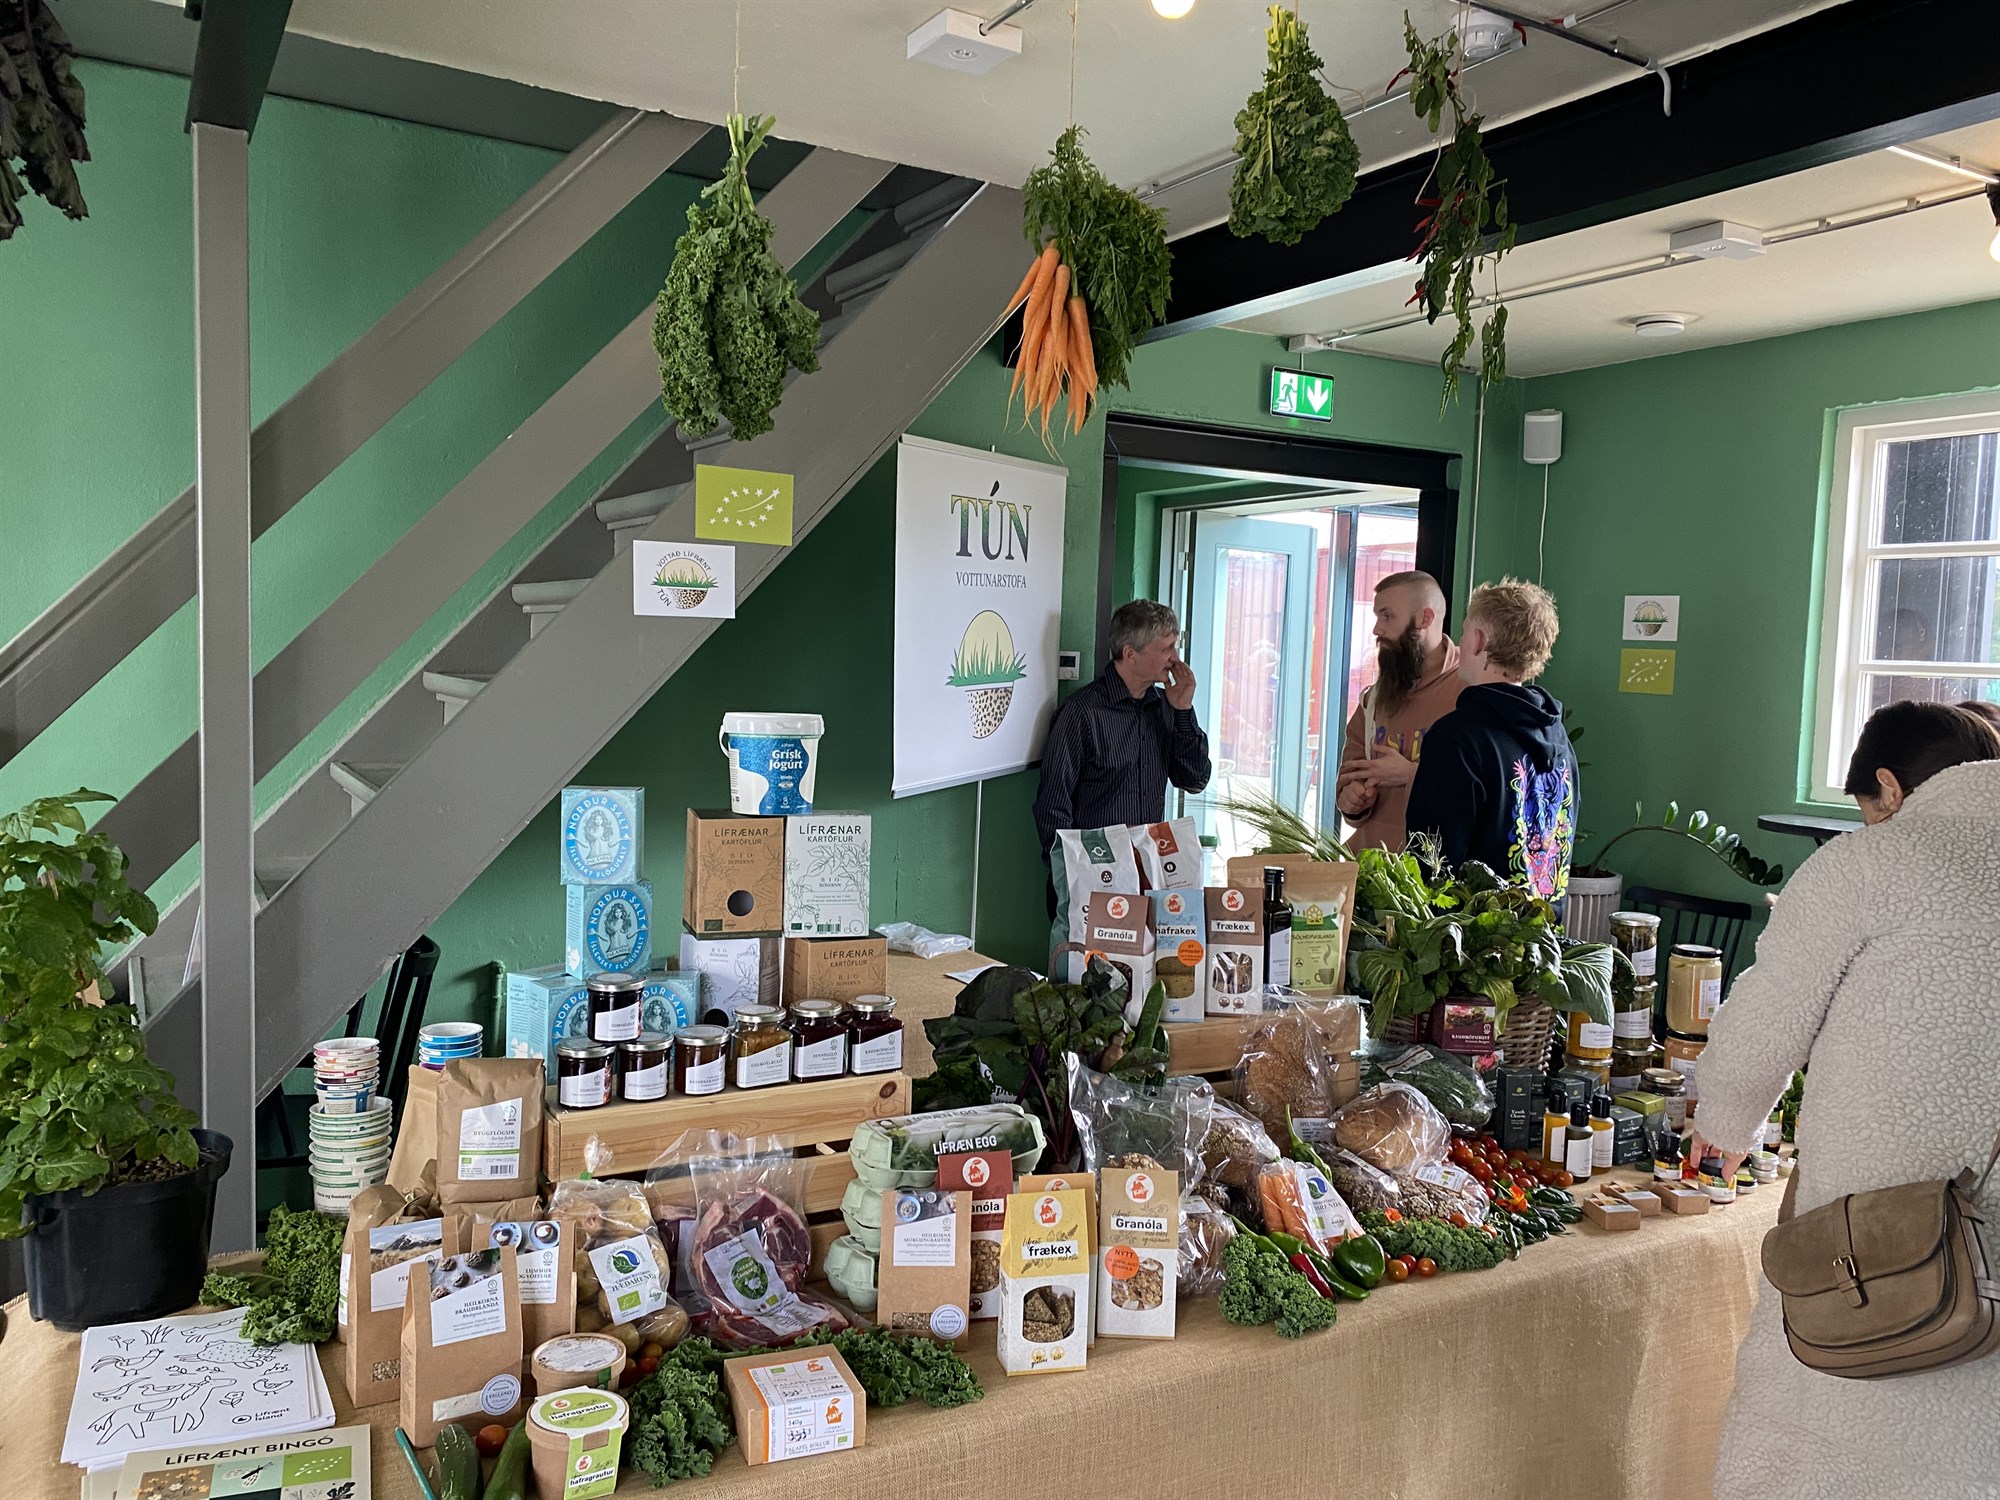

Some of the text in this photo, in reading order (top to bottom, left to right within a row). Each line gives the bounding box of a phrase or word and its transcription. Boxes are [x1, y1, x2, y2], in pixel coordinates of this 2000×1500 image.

[951, 480, 1032, 563] TÚN
[656, 549, 711, 571] VOTTAÐ LÍFRÆNT
[956, 572, 1027, 588] VOTTUNARSTOFA
[657, 588, 672, 607] TÚN
[772, 749, 801, 759] Grísk
[769, 759, 803, 772] jógúrt
[568, 797, 629, 831] NORÐUR SALT
[714, 827, 769, 837] LÍFRÆNAR
[799, 823, 862, 835] LÍFRÆNAR
[807, 835, 854, 843] KARTÖFLUR
[590, 890, 645, 924] NORÐUR SALT
[1216, 922, 1250, 930] frækex
[1097, 929, 1133, 940] Granóla
[823, 948, 874, 960] LÍFRÆNAR
[829, 959, 868, 968] KARTÖFLUR
[668, 994, 687, 1020] SALT
[933, 1135, 997, 1155] LÍFRÆN EGG
[971, 1201, 1000, 1213] anóla
[1116, 1218, 1163, 1230] Granóla
[1029, 1245, 1072, 1257] frækex
[1114, 1249, 1134, 1258] NÝTT
[464, 1297, 499, 1307] HEILKORNA
[254, 1407, 290, 1418] Lífrænt
[254, 1412, 284, 1422] Ísland
[551, 1402, 609, 1421] hafragrautur
[827, 1409, 842, 1421] Kaja
[165, 1435, 334, 1466] LÍFRÆNT BINGÓ
[569, 1468, 615, 1487] hafragrautur
